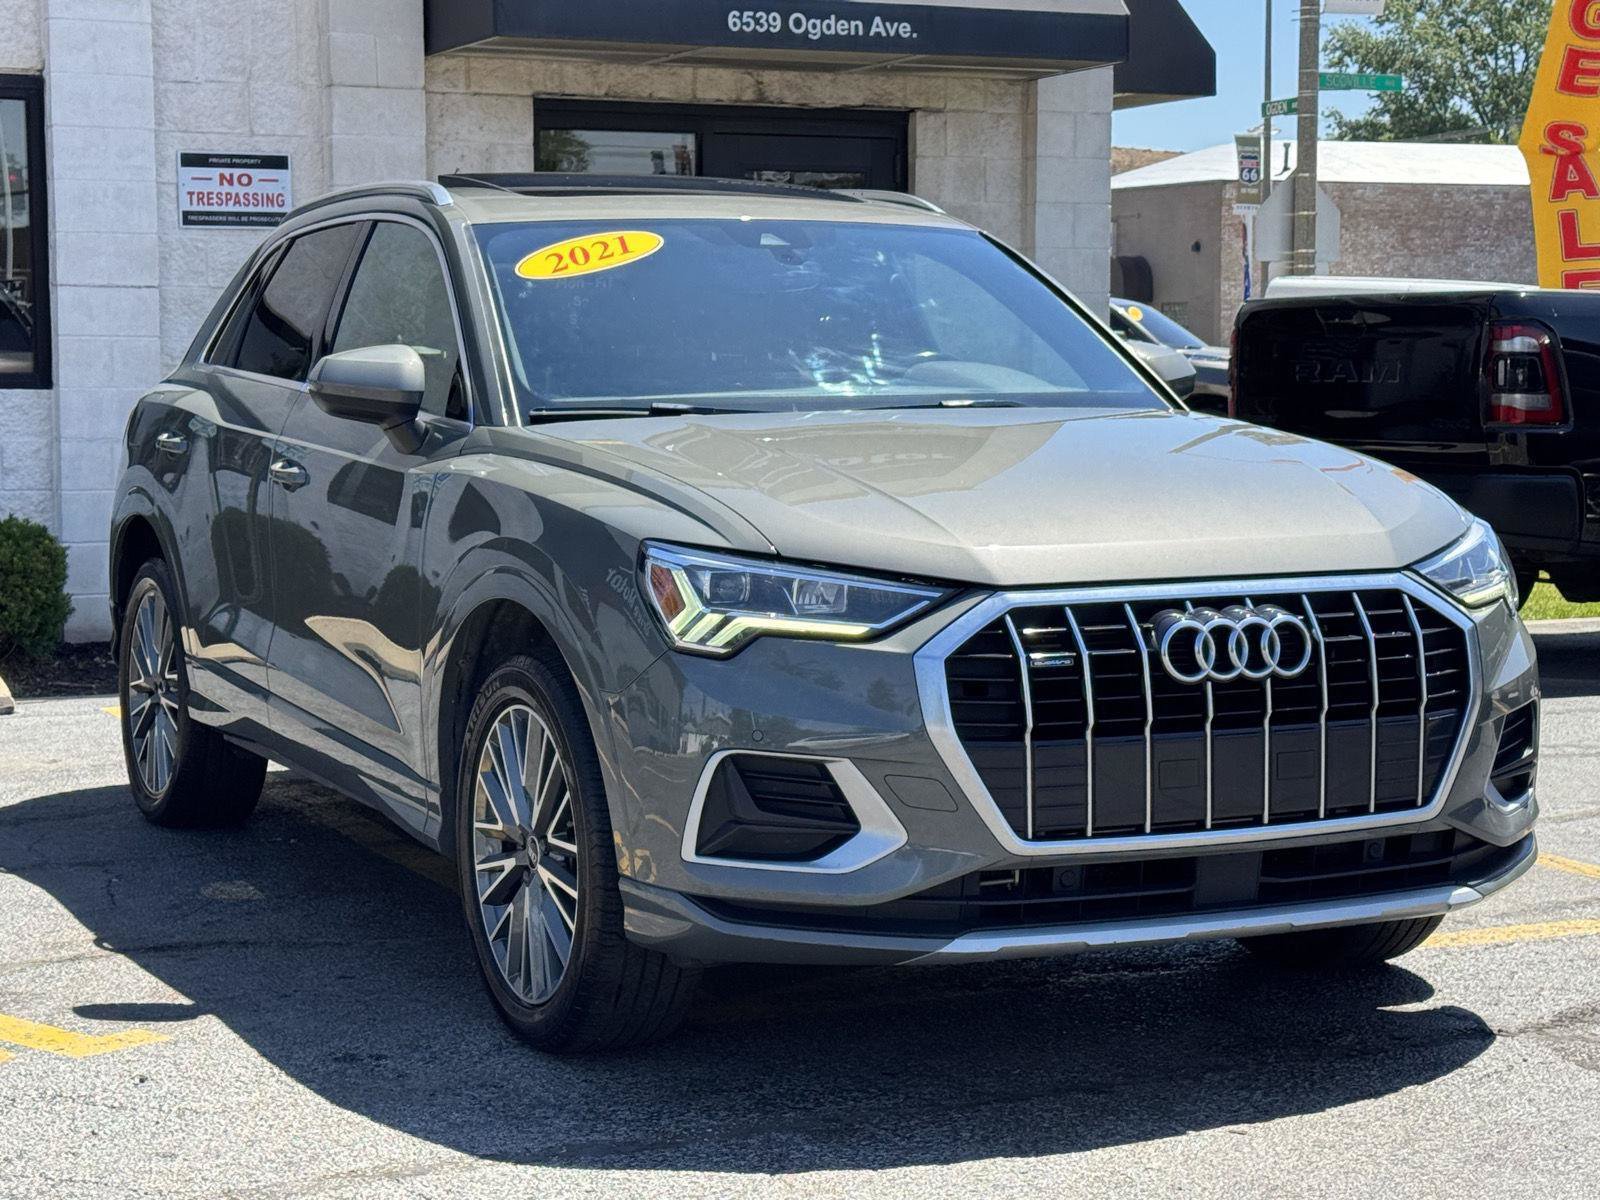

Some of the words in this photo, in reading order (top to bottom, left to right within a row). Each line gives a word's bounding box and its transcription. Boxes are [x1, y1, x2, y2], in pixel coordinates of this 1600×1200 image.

[727, 10, 782, 33] 6539
[788, 12, 864, 41] Ogden
[869, 16, 918, 38] Ave.
[1326, 74, 1377, 88] SCOVILLE
[1266, 101, 1288, 115] OGDEN
[218, 172, 253, 187] NO
[1242, 168, 1258, 181] 66
[187, 191, 285, 208] TRESPASSING
[545, 235, 632, 274] 2021
[1294, 359, 1402, 384] RAM
